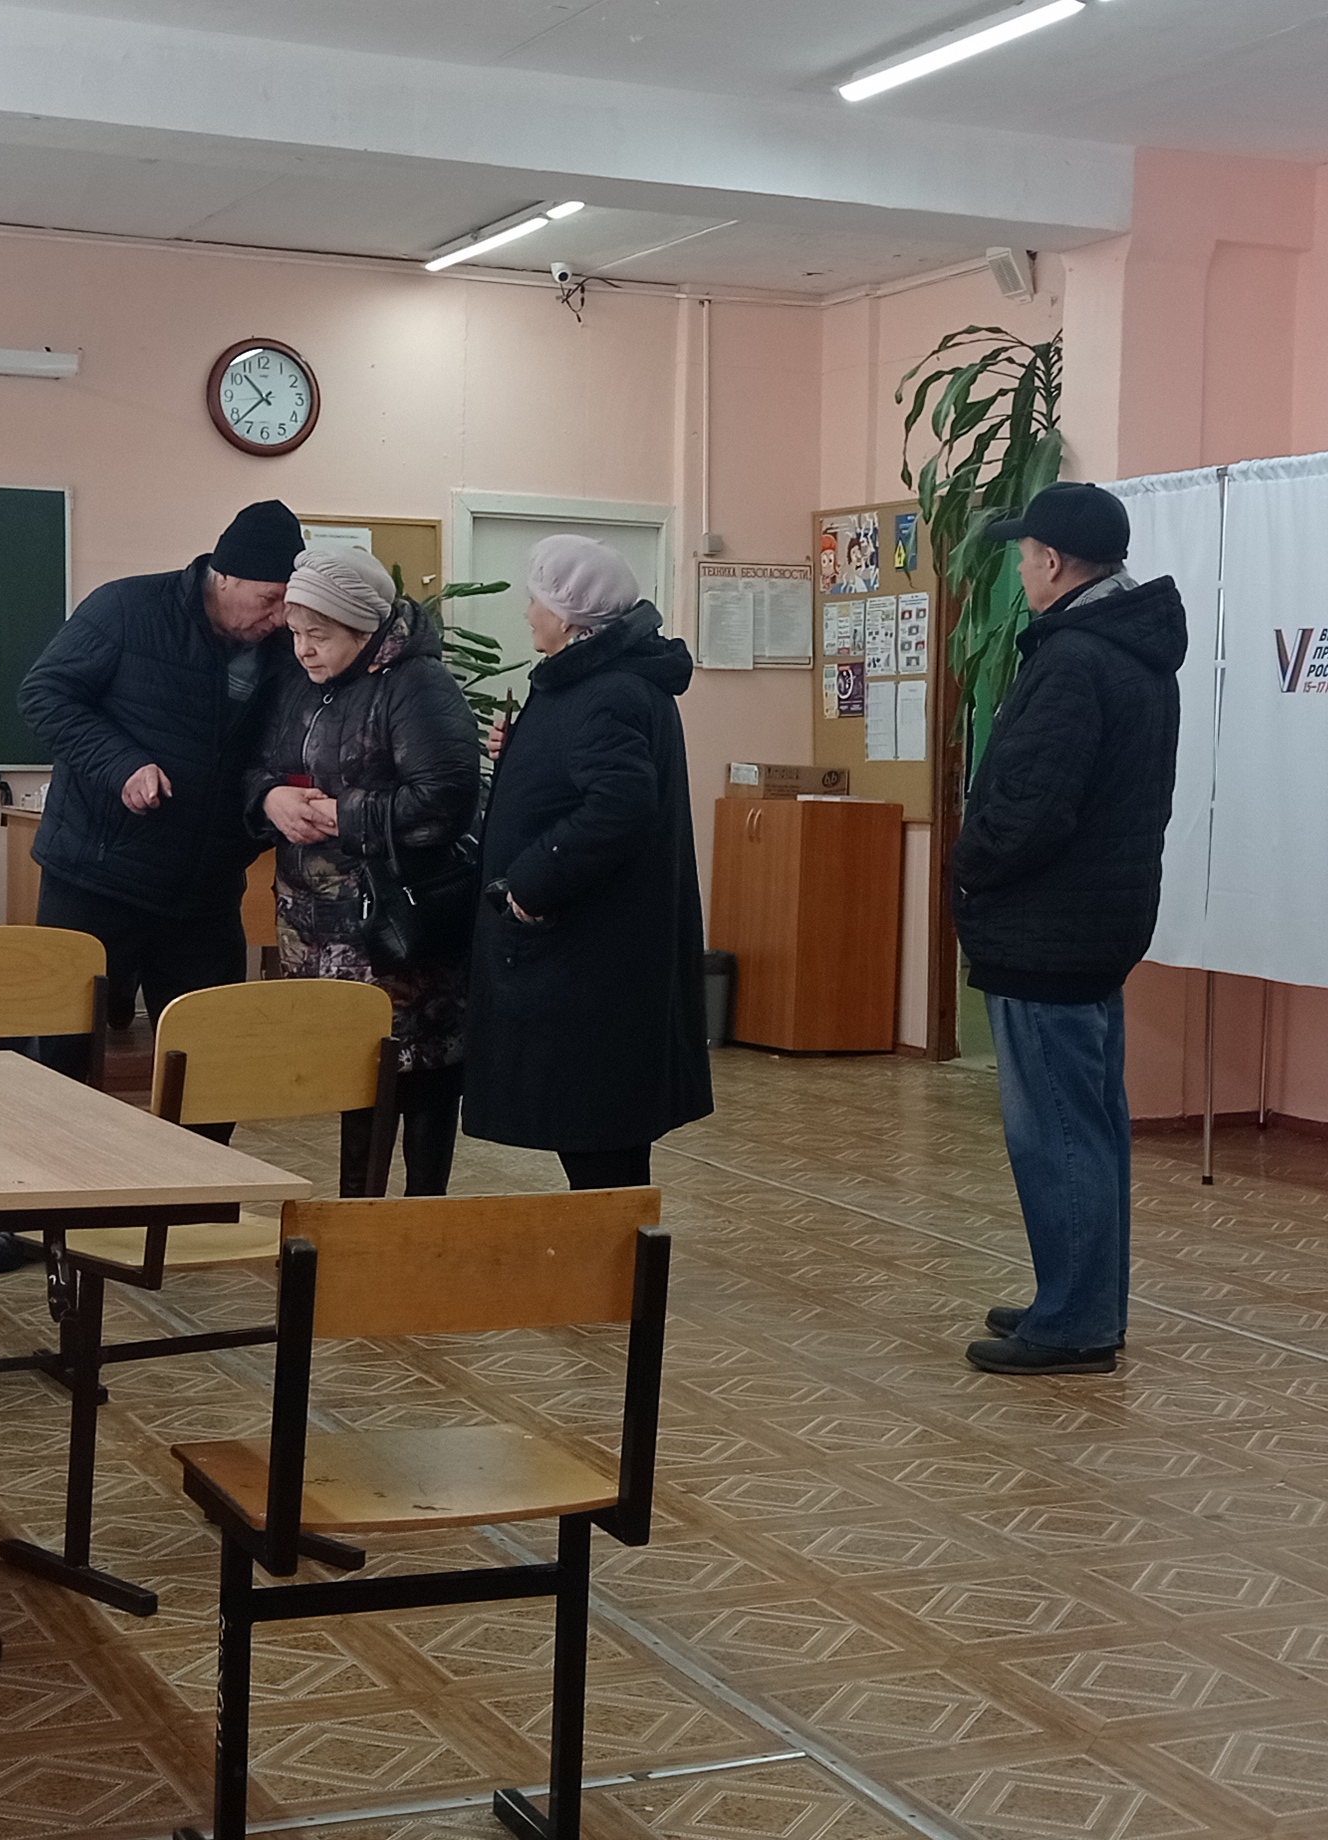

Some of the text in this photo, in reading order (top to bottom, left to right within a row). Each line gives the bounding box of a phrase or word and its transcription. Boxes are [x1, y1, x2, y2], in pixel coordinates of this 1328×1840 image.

[243, 361, 252, 374] 11
[257, 356, 270, 370] 12
[230, 372, 243, 386] 10
[288, 374, 298, 388] 2
[224, 389, 234, 403] 9
[295, 393, 304, 407] 3
[230, 407, 240, 421] 8
[289, 410, 298, 424] 4
[244, 420, 254, 435] 7
[260, 426, 270, 440] 6
[277, 422, 287, 437] 5
[702, 565, 737, 577] ТЕХНИКА
